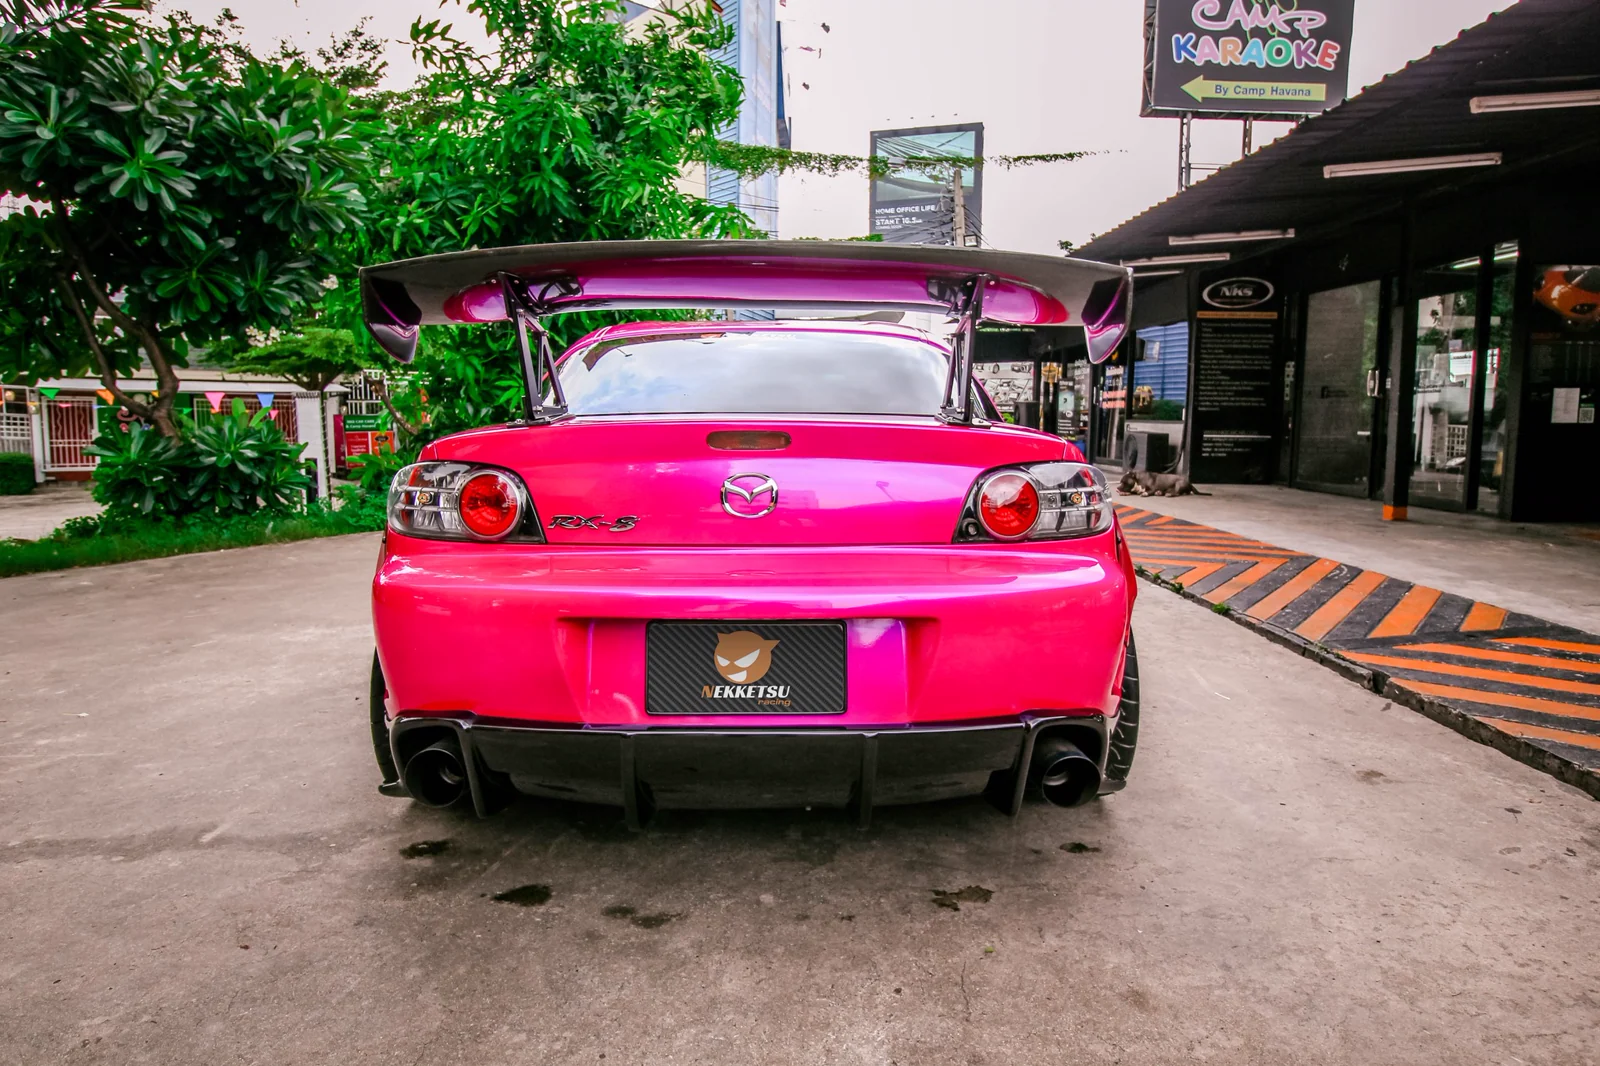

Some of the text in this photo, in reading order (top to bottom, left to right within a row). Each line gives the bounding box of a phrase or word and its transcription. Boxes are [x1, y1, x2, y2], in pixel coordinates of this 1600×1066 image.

[1172, 33, 1340, 71] KARAOKE
[1214, 84, 1311, 97] By Camp Havana
[875, 204, 936, 215] HOME OFFICE LIFE
[875, 218, 900, 226] START
[1219, 286, 1254, 297] NKS
[547, 514, 640, 532] RX-8
[701, 685, 791, 698] NEKKETSU
[757, 698, 791, 707] racing
